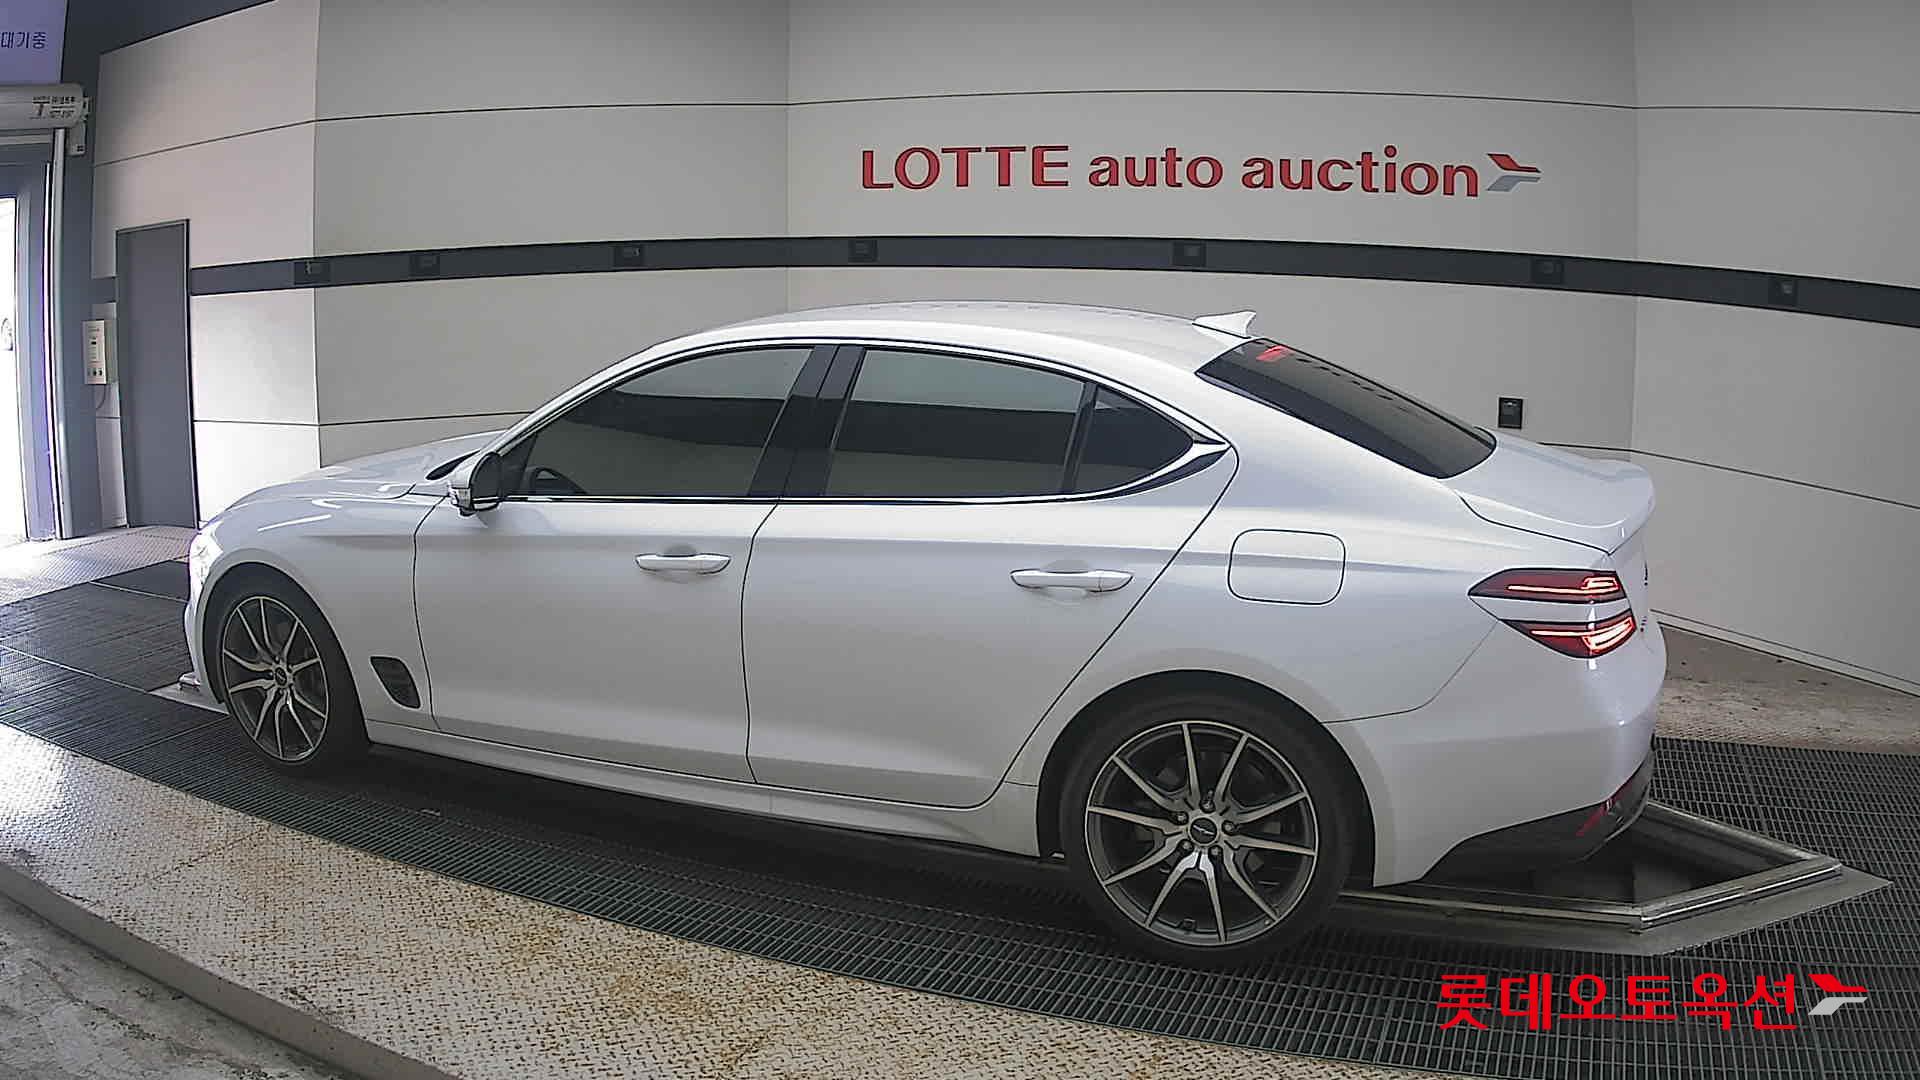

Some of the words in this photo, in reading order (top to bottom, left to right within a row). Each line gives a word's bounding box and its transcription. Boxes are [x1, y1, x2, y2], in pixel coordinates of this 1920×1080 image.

[0, 31, 48, 50] 대기중
[861, 145, 1069, 190] LOTTE
[1087, 147, 1224, 189] auto
[1240, 145, 1479, 197] auction
